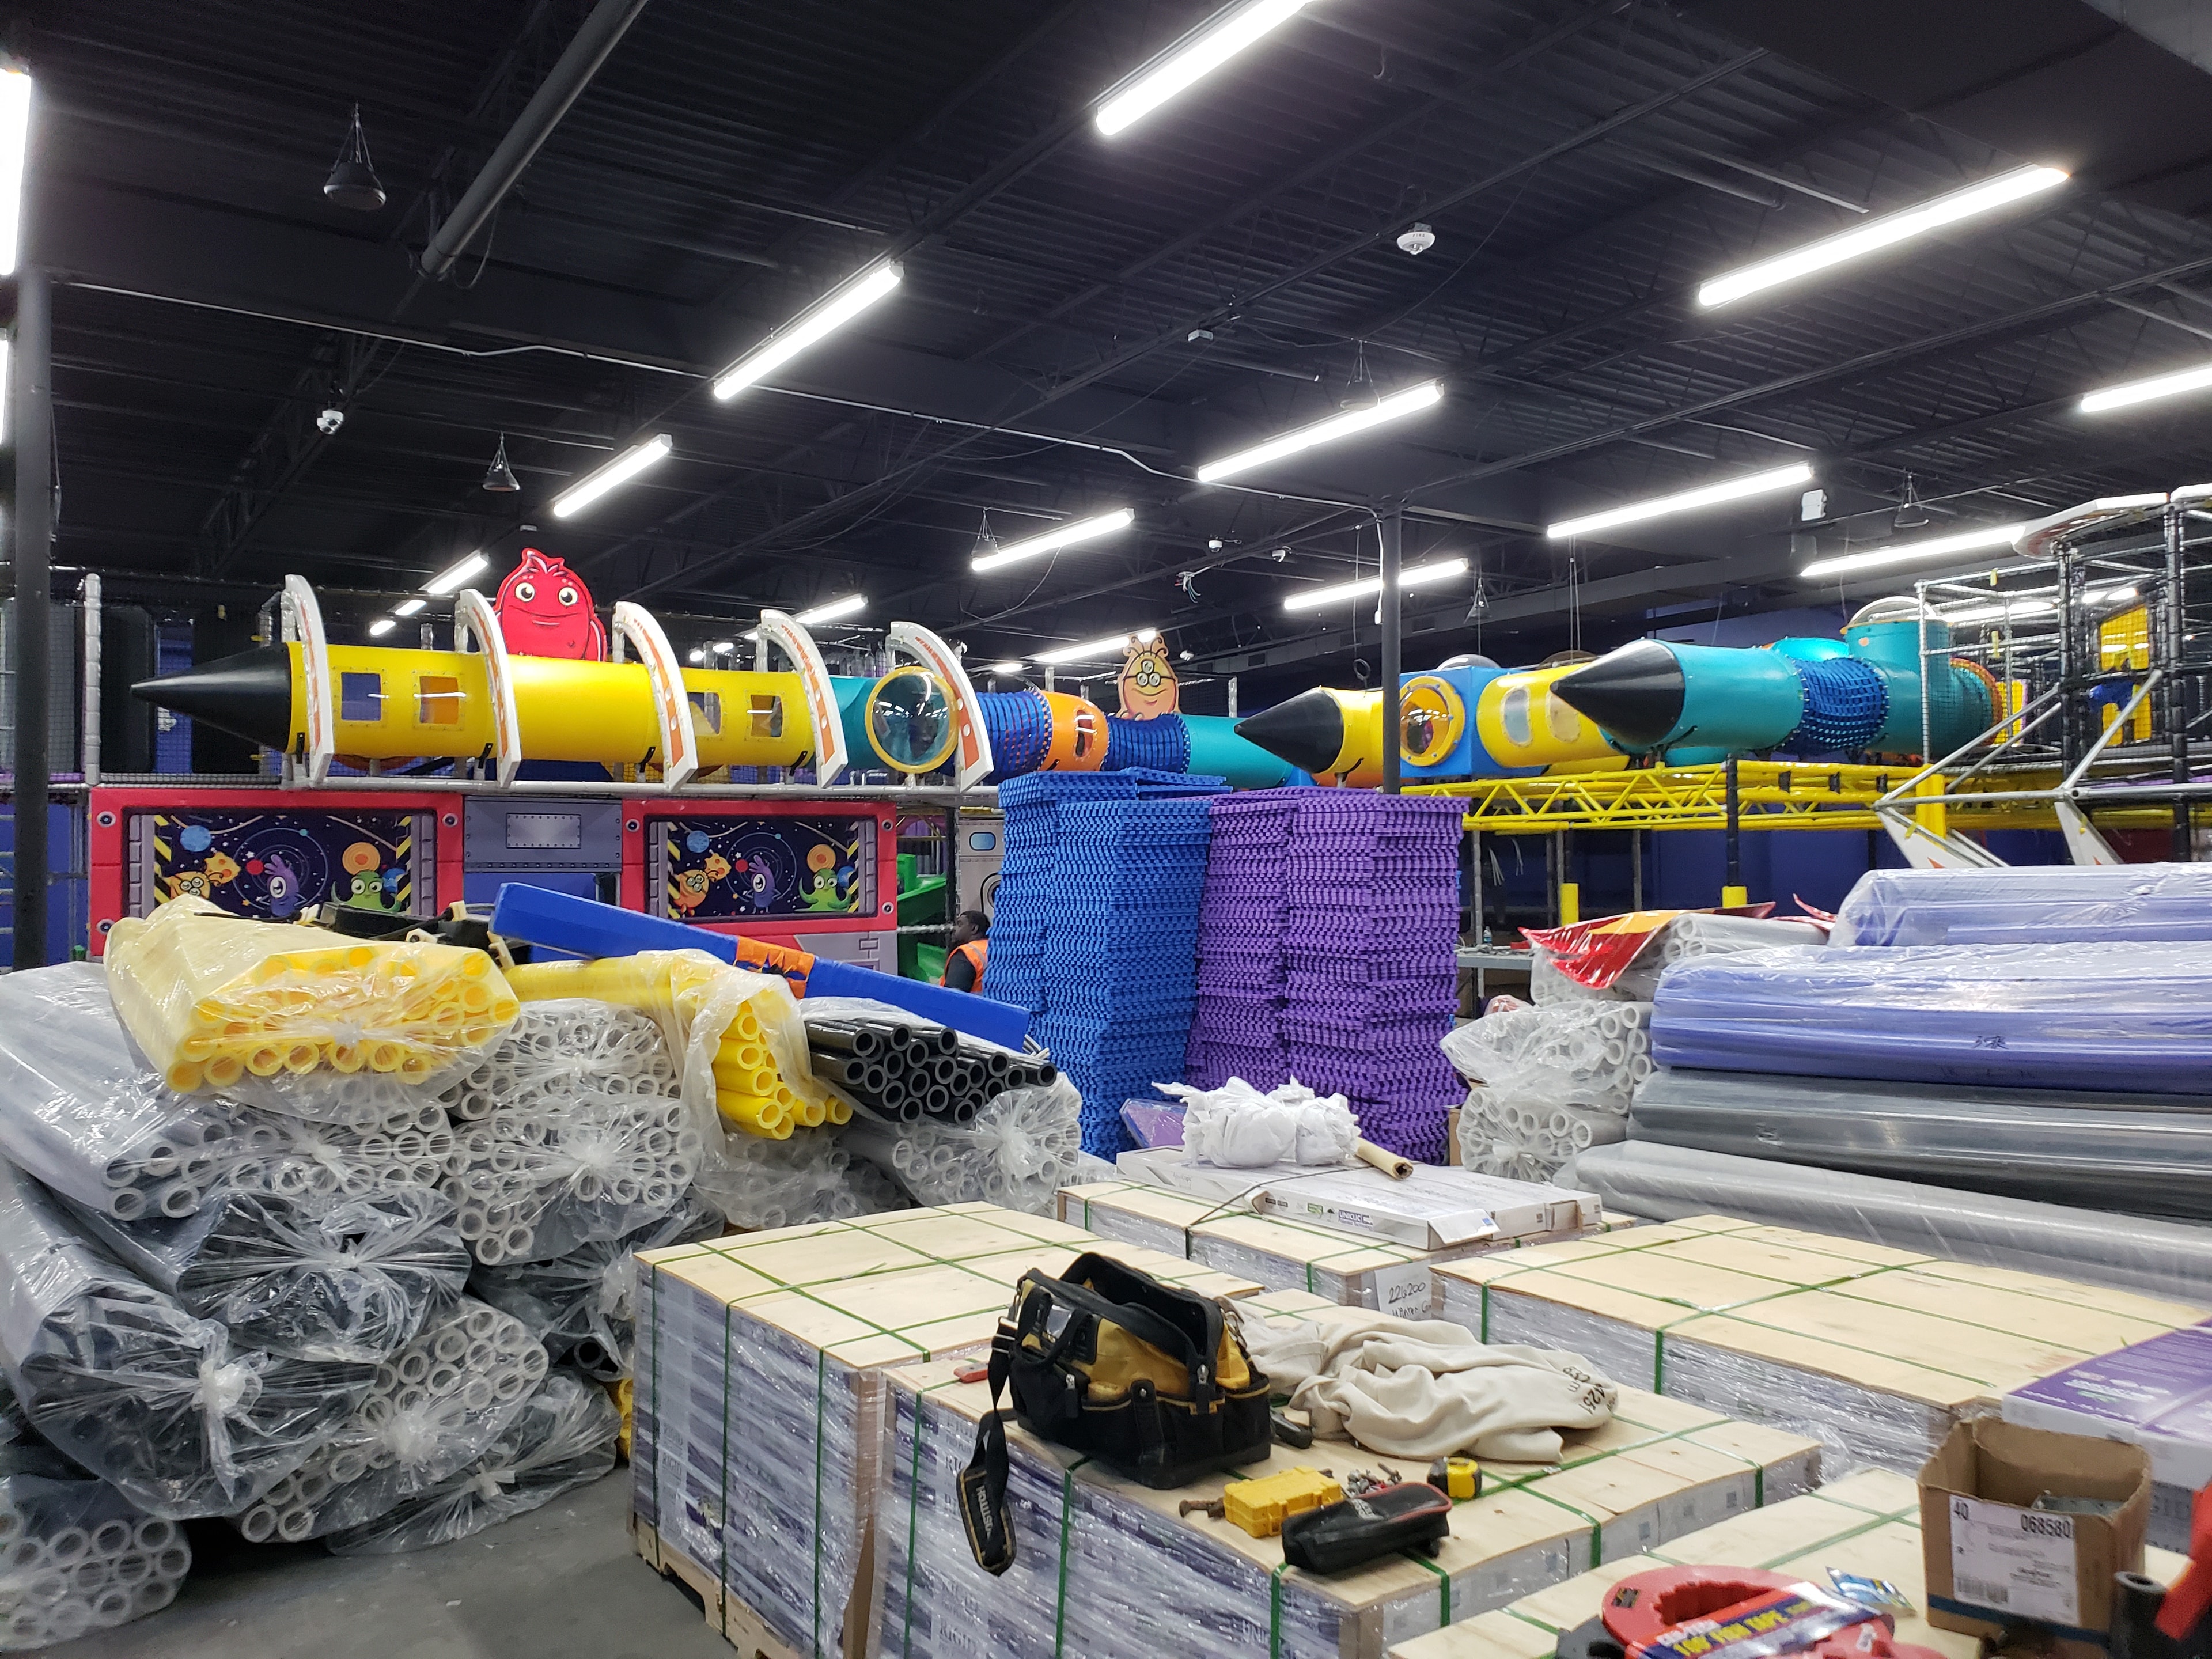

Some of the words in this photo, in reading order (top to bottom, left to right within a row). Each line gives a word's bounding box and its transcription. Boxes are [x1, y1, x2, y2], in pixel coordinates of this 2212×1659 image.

[1339, 1210, 1362, 1222] UNICLIC
[976, 1485, 994, 1540] OSTITCH
[2021, 1513, 2071, 1539] 068580
